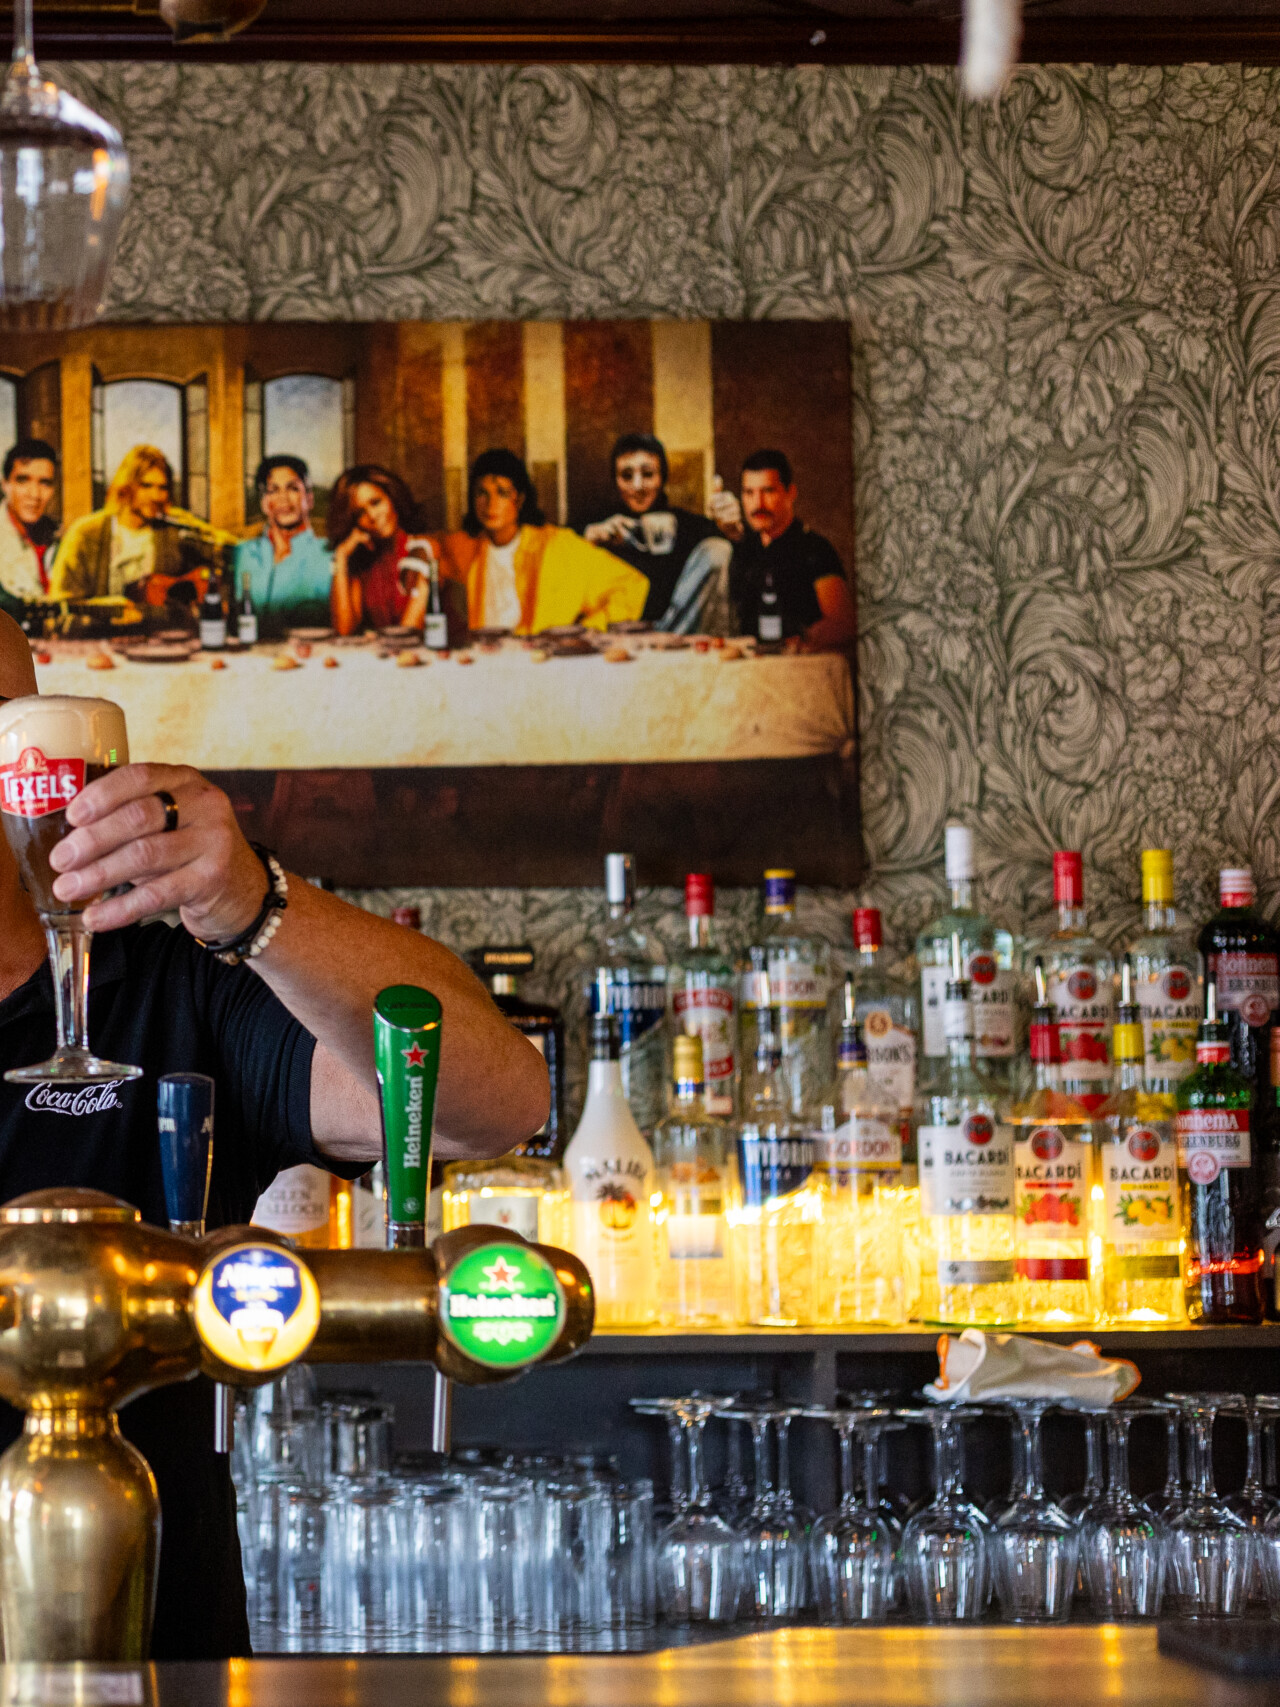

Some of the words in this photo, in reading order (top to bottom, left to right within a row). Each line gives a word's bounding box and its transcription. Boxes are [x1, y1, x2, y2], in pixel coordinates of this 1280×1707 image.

[0, 771, 77, 803] TEXELS
[403, 1075, 424, 1169] Heineken
[449, 1293, 557, 1317] Heineken
